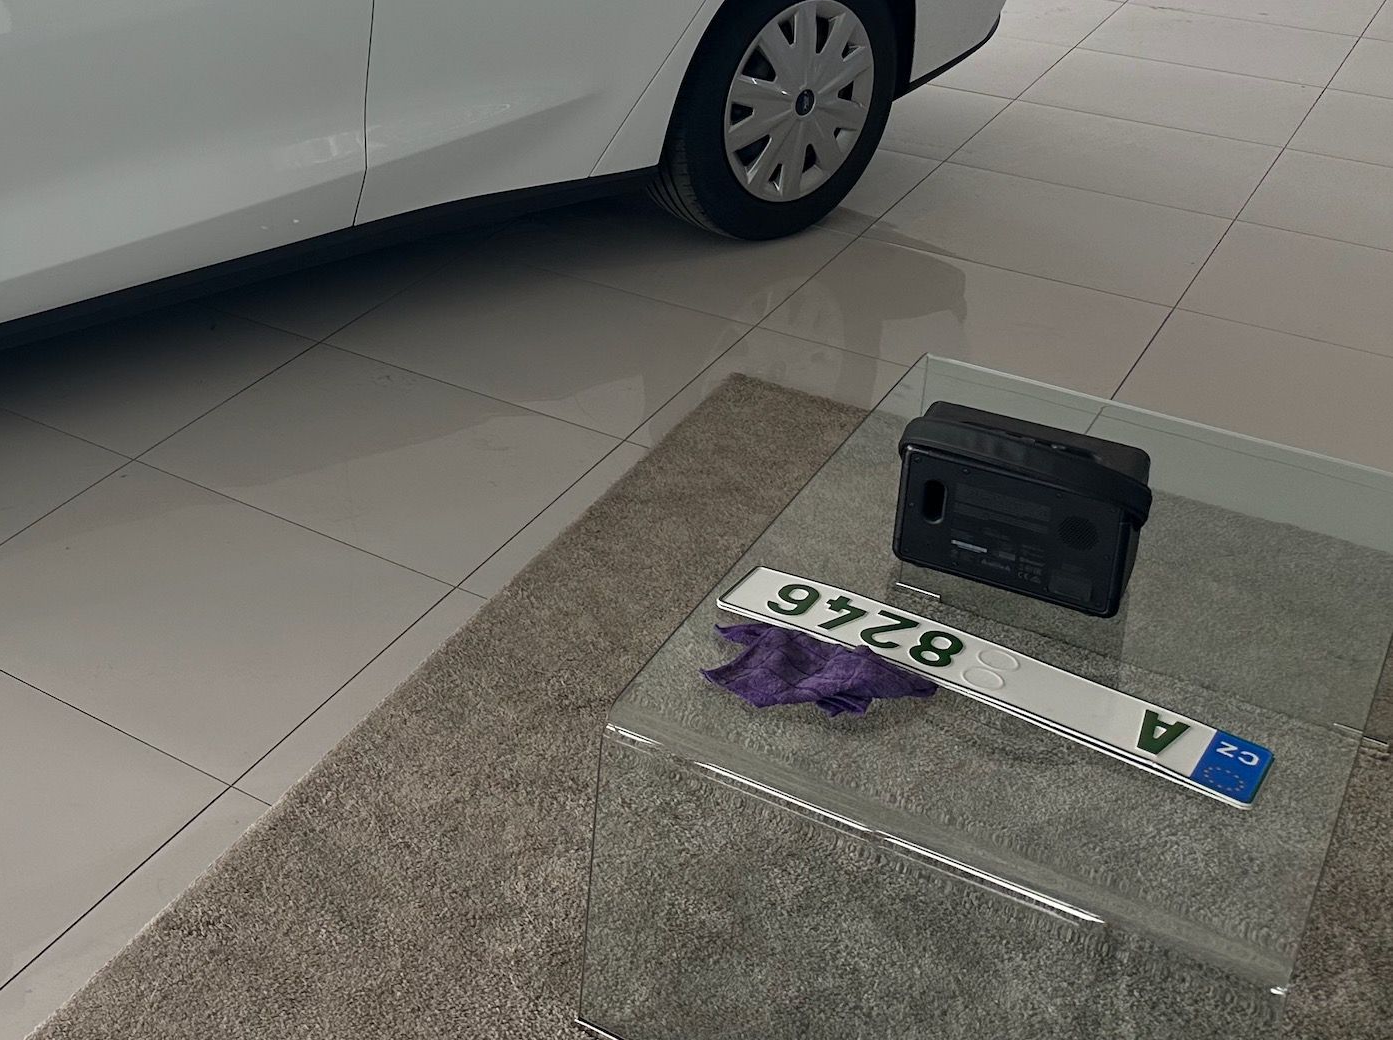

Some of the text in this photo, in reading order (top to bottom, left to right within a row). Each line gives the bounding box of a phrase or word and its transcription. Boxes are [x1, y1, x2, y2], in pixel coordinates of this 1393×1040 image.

[766, 583, 1260, 766] CZ A 8246
